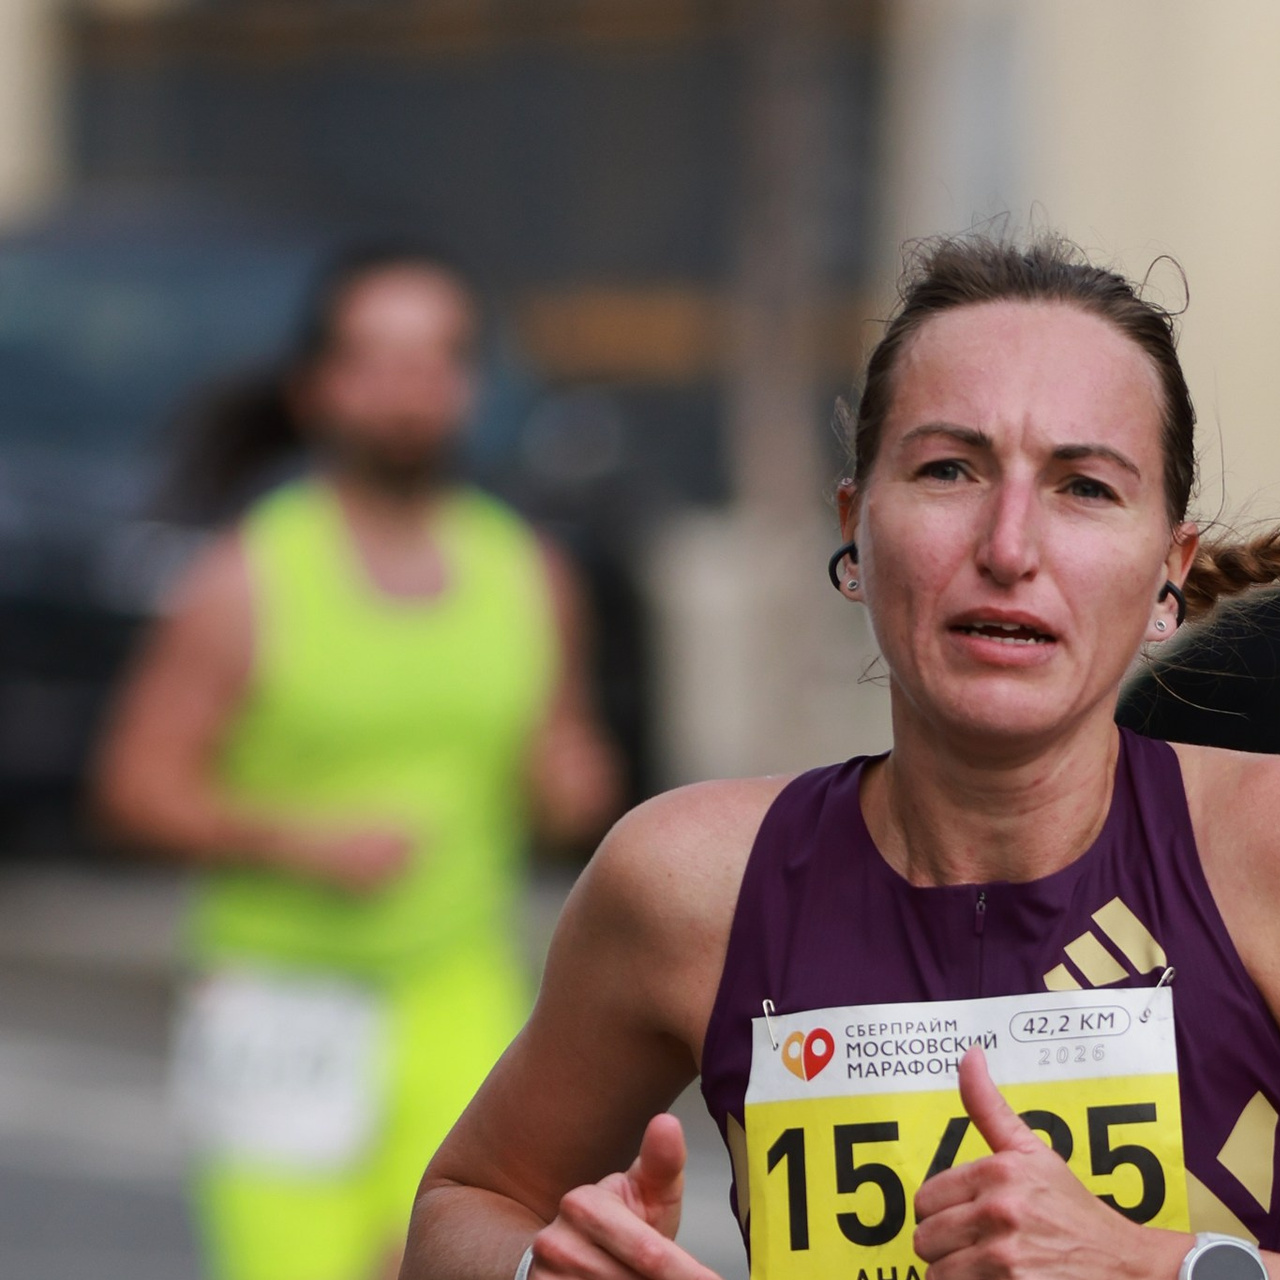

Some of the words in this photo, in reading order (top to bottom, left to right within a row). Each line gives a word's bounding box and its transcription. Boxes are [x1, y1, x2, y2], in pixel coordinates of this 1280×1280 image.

[845, 1018, 957, 1038] СБЕРПРАЙМ
[1023, 1014, 1070, 1035] 42,2
[1038, 1044, 1105, 1065] 2026
[847, 1057, 959, 1079] МАРАФОН
